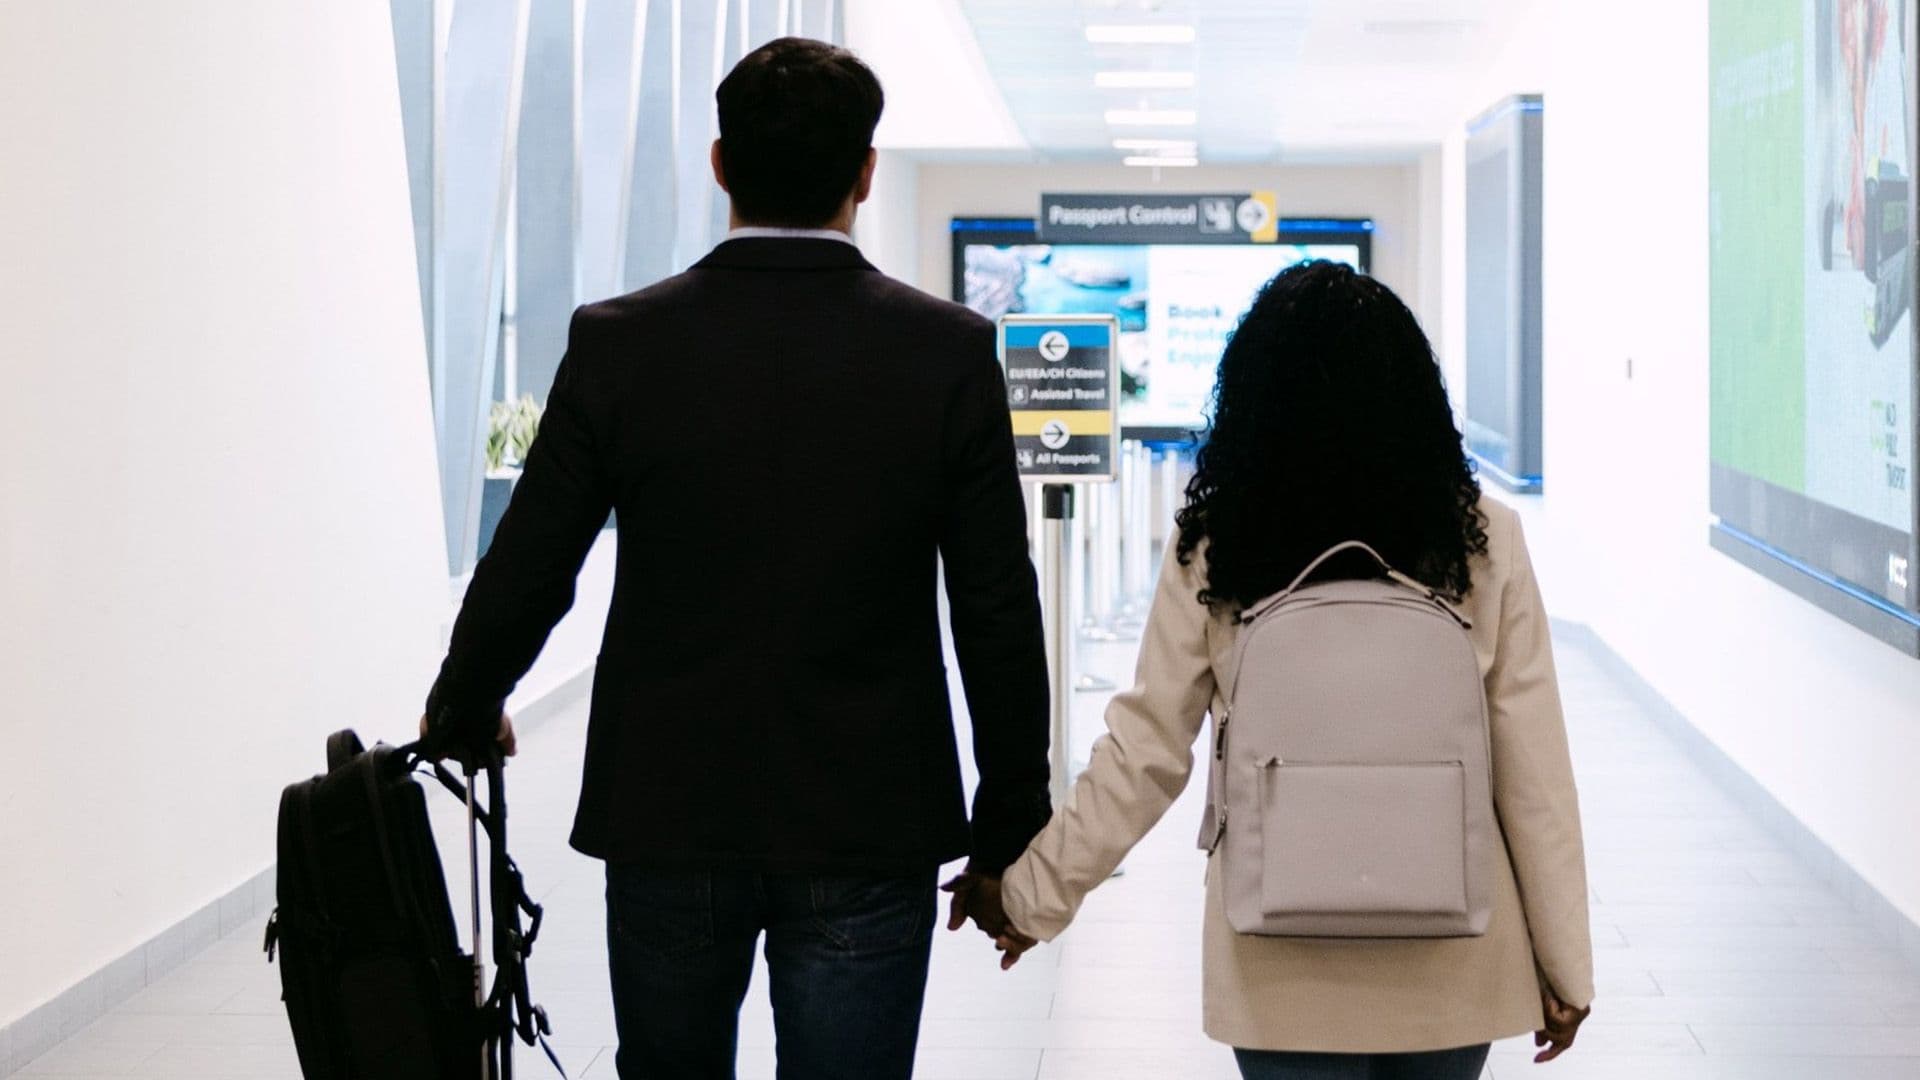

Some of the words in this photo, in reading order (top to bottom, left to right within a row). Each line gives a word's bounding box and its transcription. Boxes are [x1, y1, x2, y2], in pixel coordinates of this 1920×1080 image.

[1049, 205, 1127, 229] Passport
[1128, 204, 1197, 226] Control
[1168, 326, 1227, 341] Prote
[1168, 348, 1217, 370] Enjo
[1008, 367, 1065, 379] EU/EEA/CH
[1065, 367, 1106, 379] Citizens
[1030, 388, 1073, 400] Assisted
[1074, 388, 1105, 400] Travel
[1036, 452, 1051, 464] All
[1052, 452, 1100, 466] Passports
